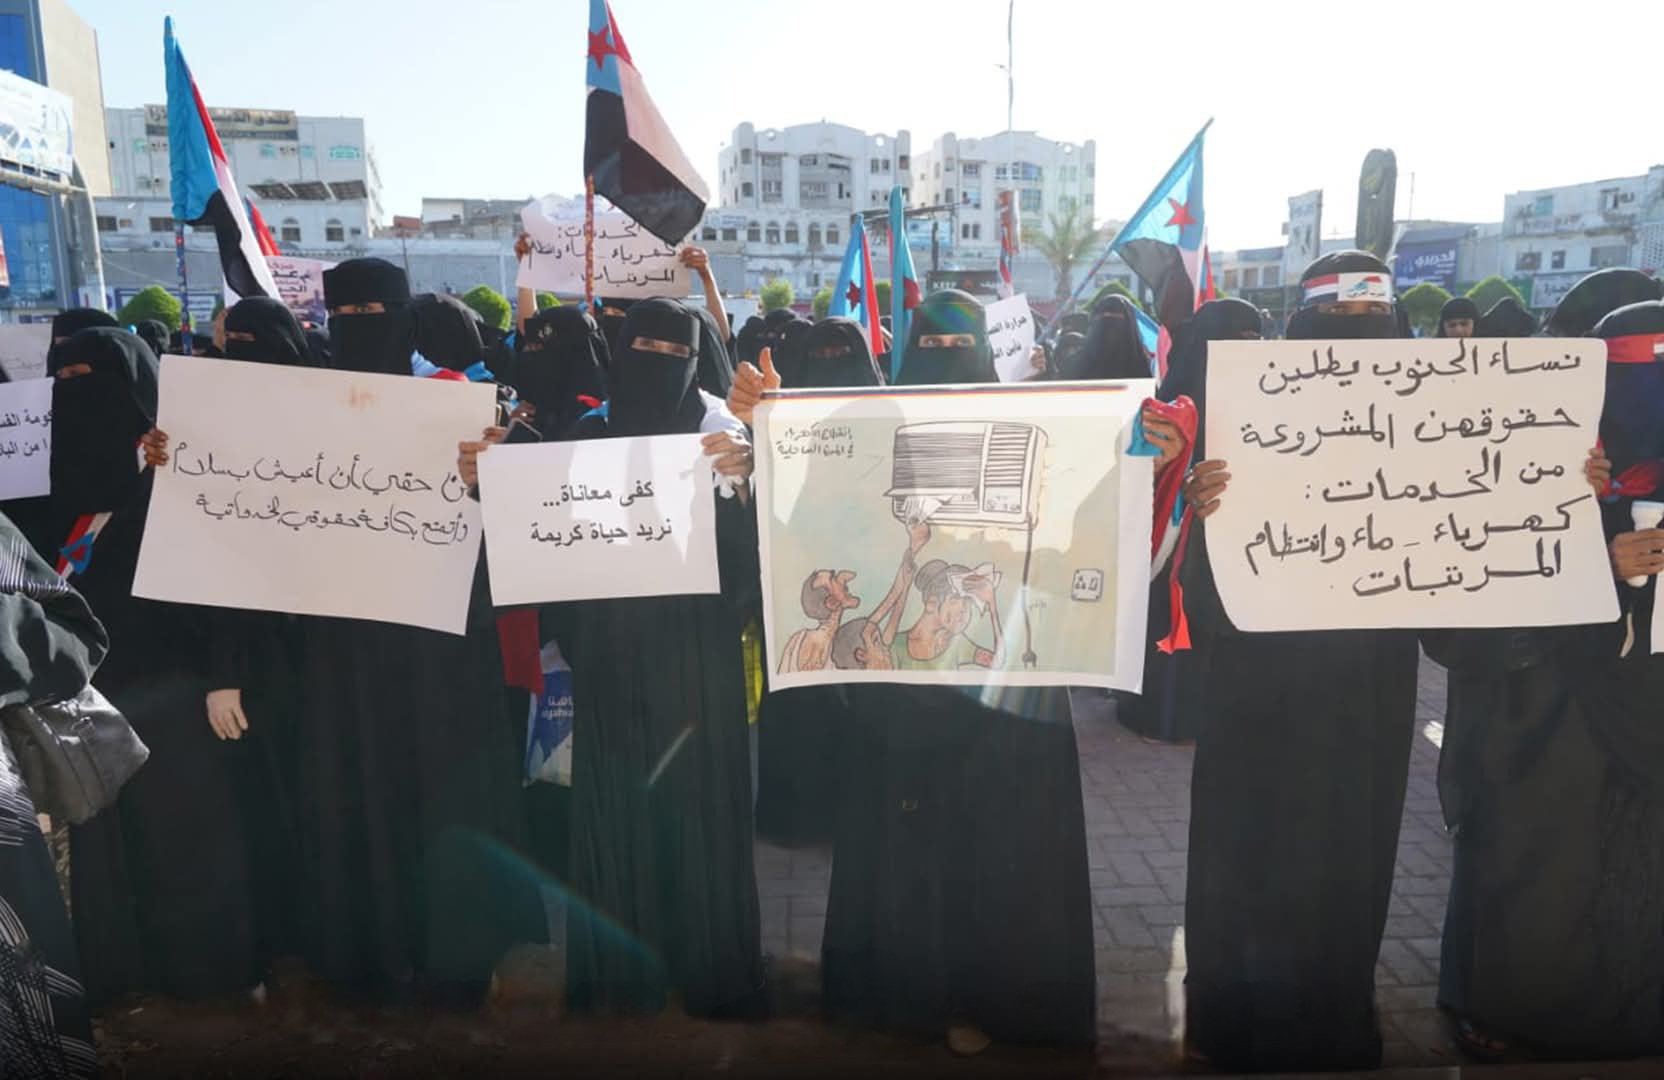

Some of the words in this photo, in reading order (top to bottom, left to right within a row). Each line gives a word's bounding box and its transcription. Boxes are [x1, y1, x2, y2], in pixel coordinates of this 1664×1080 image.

[1372, 337, 1479, 396] الجنوب
[1488, 340, 1582, 375] نساء
[1240, 402, 1395, 457] المشروعة
[1414, 406, 1582, 443] حقوقهن
[173, 441, 251, 482] بسلام
[254, 451, 325, 485] أعيش
[329, 453, 361, 491] أن
[1519, 461, 1565, 484] من
[619, 479, 655, 507] كفى
[530, 521, 584, 548] كريمة
[590, 521, 629, 544] حياة
[636, 518, 673, 542] نريد
[1352, 512, 1395, 551] ماء
[1433, 493, 1593, 551] كهرباء
[1244, 520, 1346, 577] وانتظام
